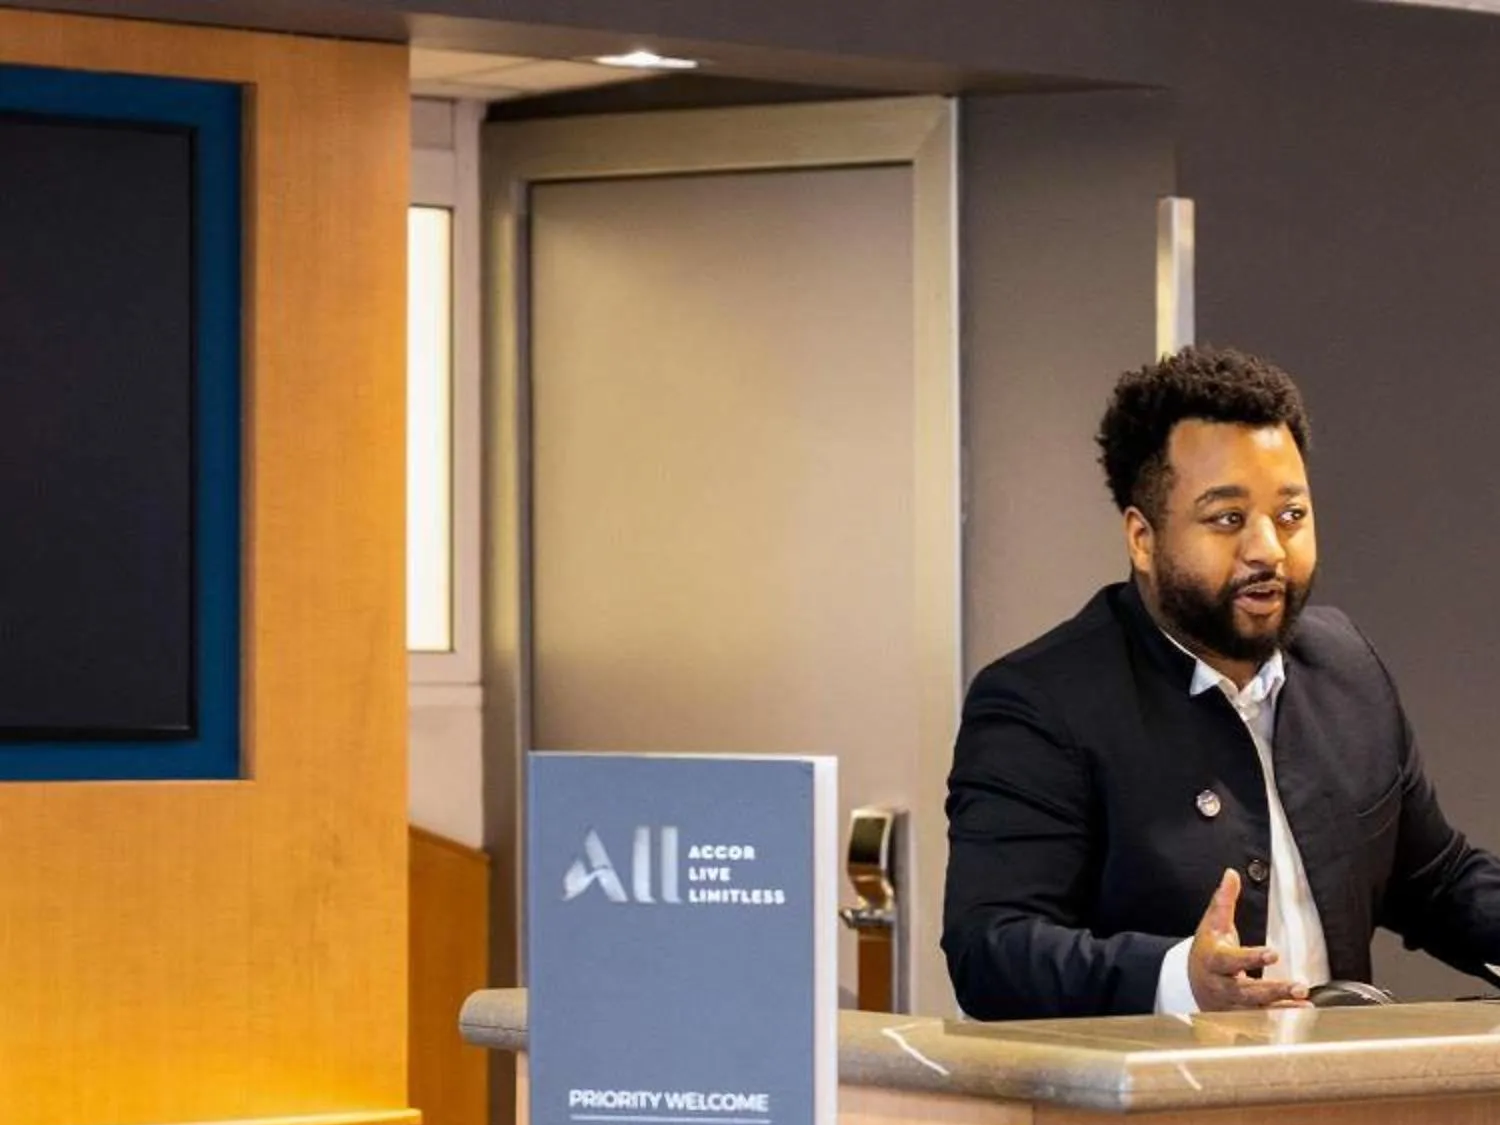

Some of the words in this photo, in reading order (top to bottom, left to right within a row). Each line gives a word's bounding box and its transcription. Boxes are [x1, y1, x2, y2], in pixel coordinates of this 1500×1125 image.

[688, 845, 756, 860] ACCOR
[688, 866, 730, 881] LIVE
[688, 889, 786, 905] LIMITLESS
[568, 1089, 661, 1109] PRIORITY
[664, 1092, 769, 1112] WELCOME
